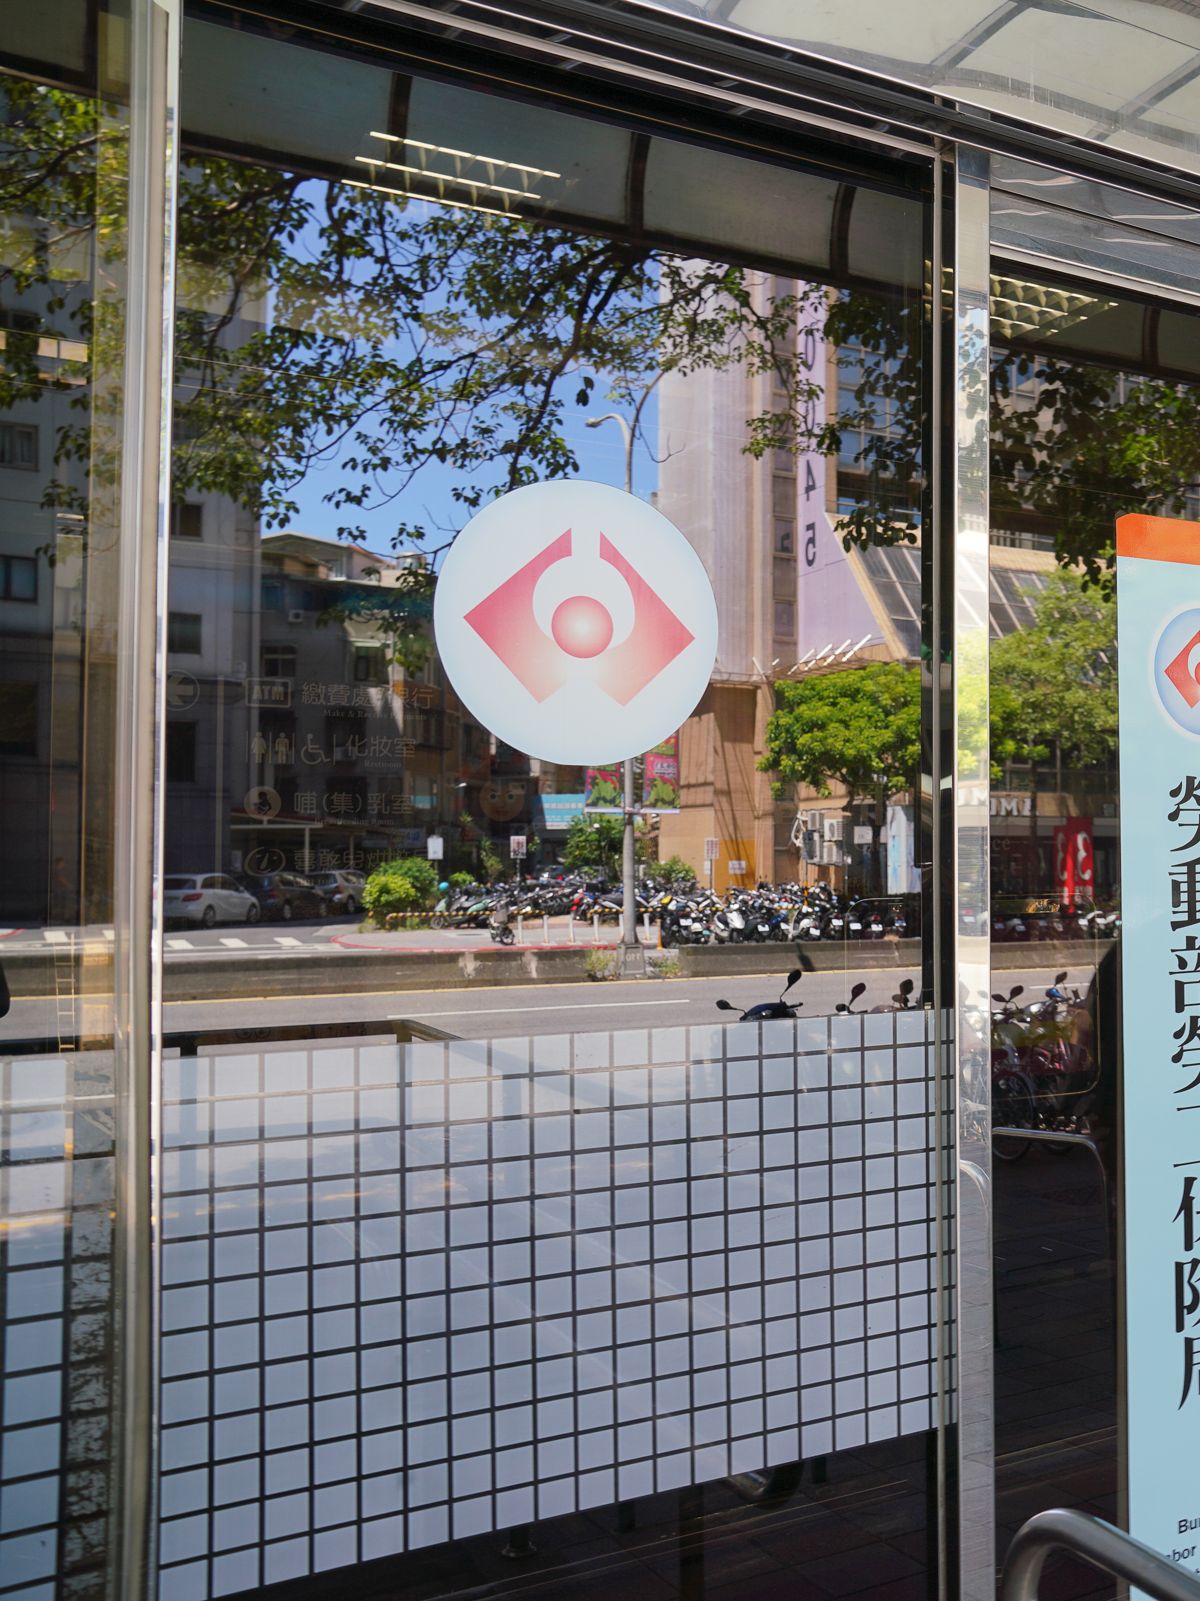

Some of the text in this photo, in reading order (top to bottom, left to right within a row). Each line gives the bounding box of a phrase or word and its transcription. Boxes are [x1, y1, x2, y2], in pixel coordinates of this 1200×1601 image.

[252, 685, 285, 701] ATM
[345, 734, 417, 758] 化妝室
